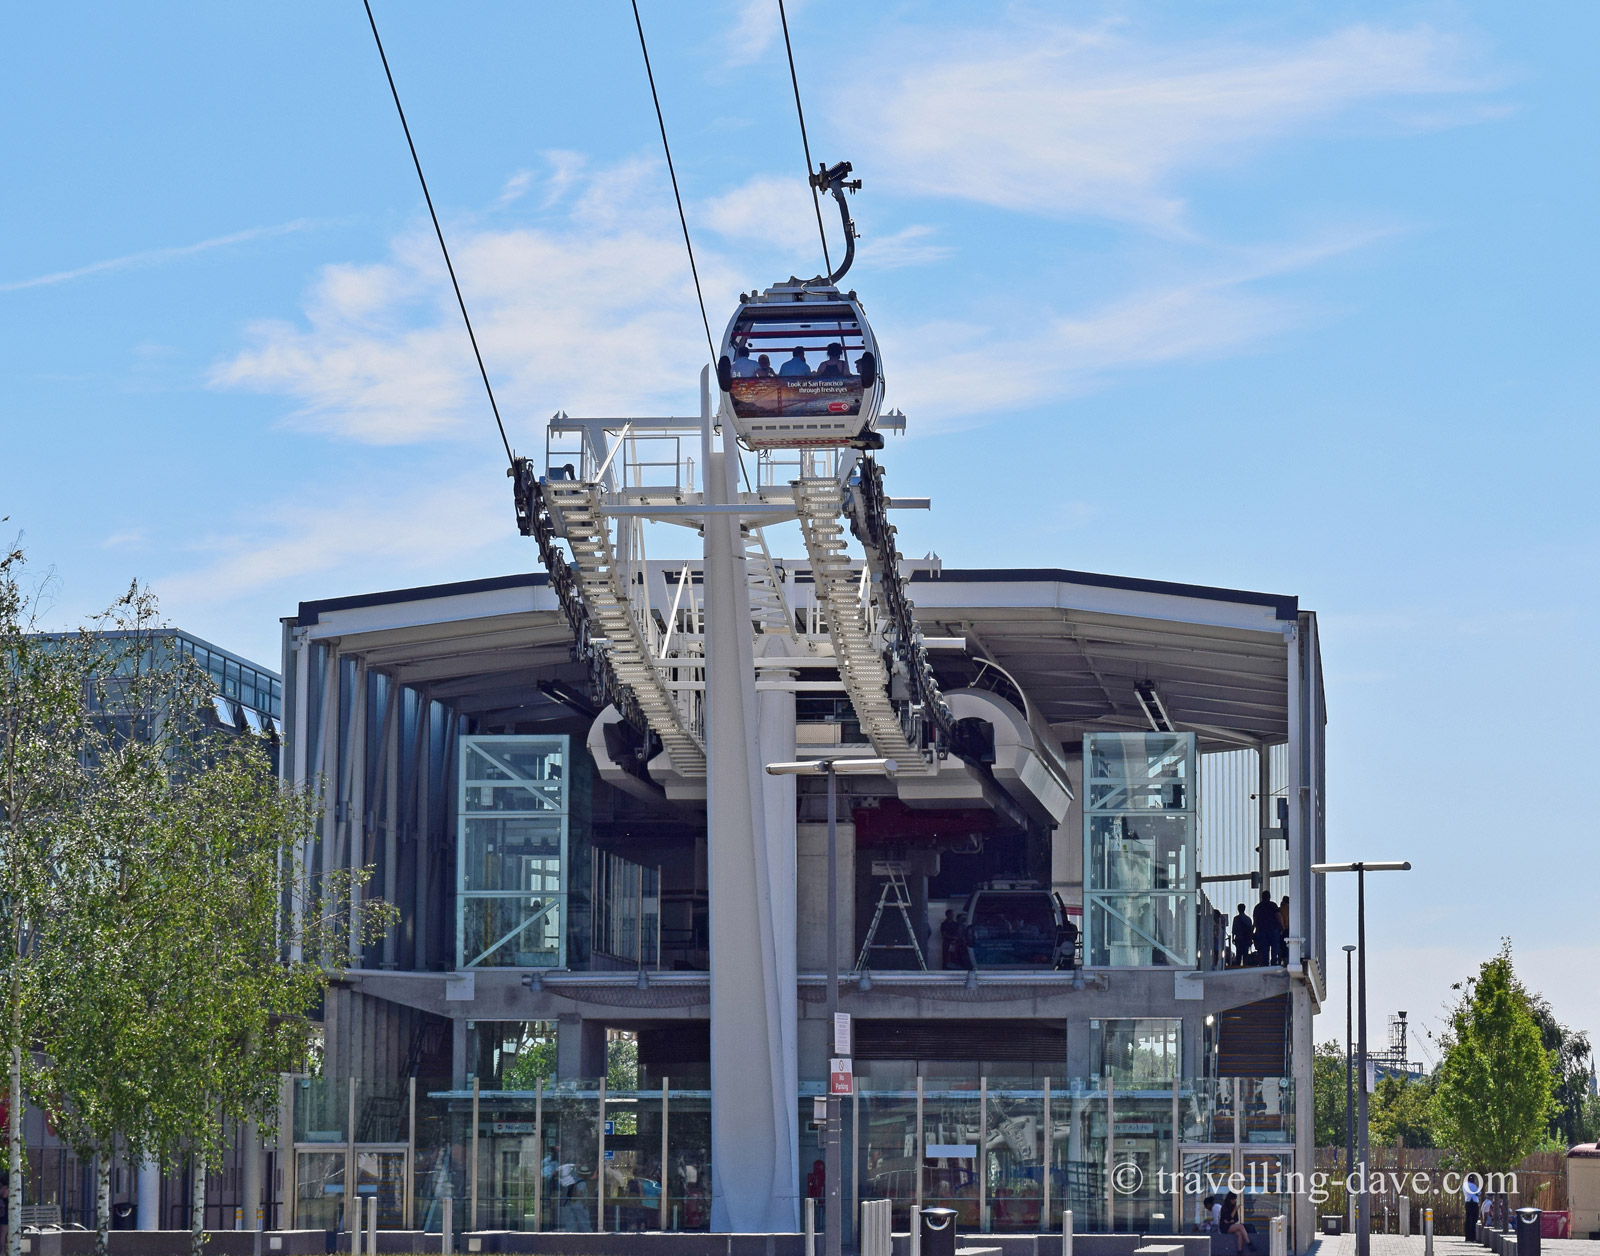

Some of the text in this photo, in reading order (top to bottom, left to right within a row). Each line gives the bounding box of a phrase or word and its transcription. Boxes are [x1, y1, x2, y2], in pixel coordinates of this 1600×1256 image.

[799, 387, 820, 395] through
[838, 1073, 845, 1081] No
[835, 1082, 849, 1092] Parking
